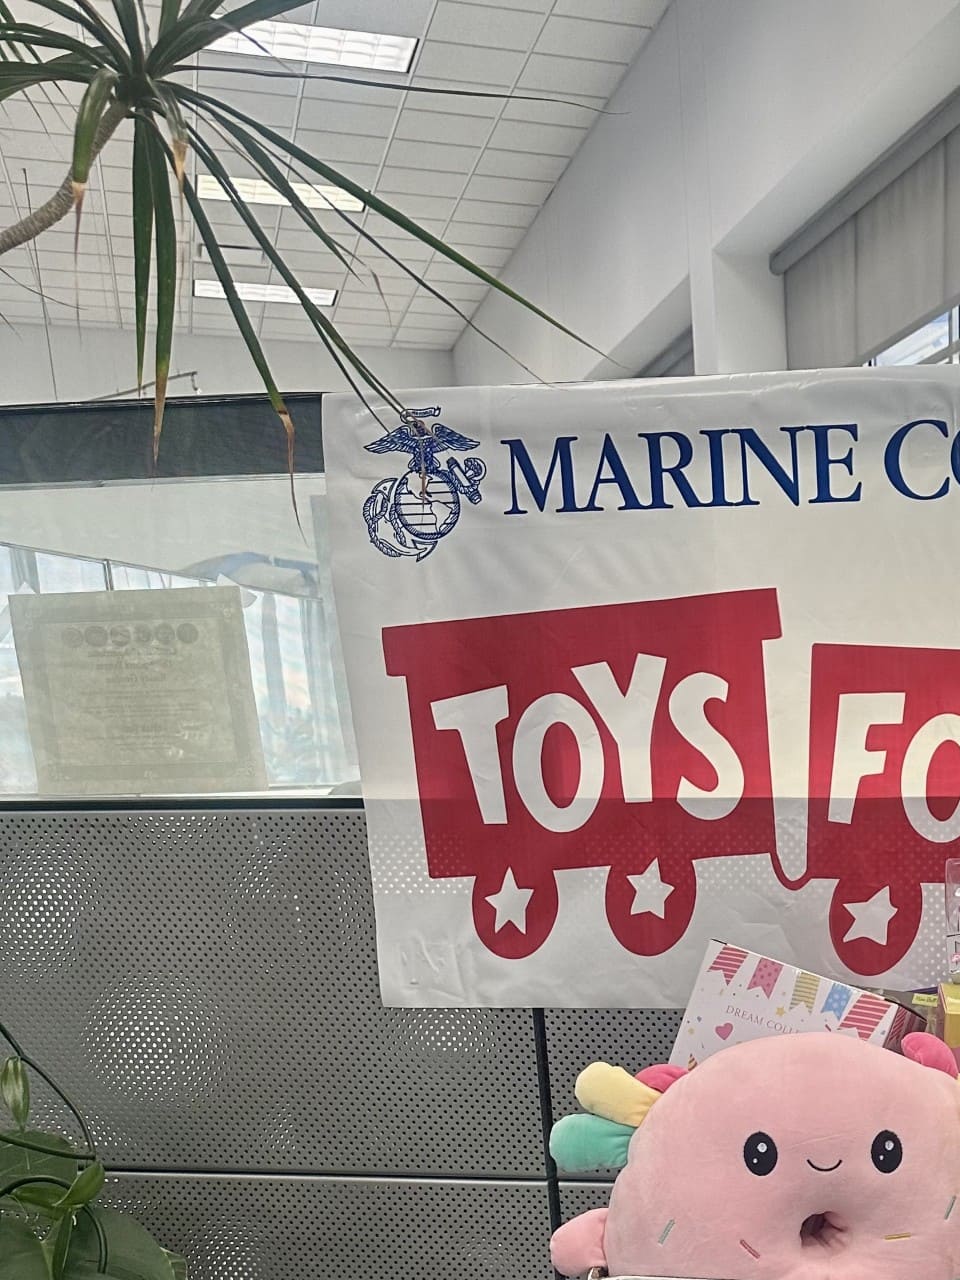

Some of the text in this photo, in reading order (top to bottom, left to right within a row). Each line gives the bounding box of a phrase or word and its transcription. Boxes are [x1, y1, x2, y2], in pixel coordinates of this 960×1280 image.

[501, 424, 863, 515] MARINE
[430, 653, 745, 833] TOYS
[726, 1005, 764, 1027] DREAM
